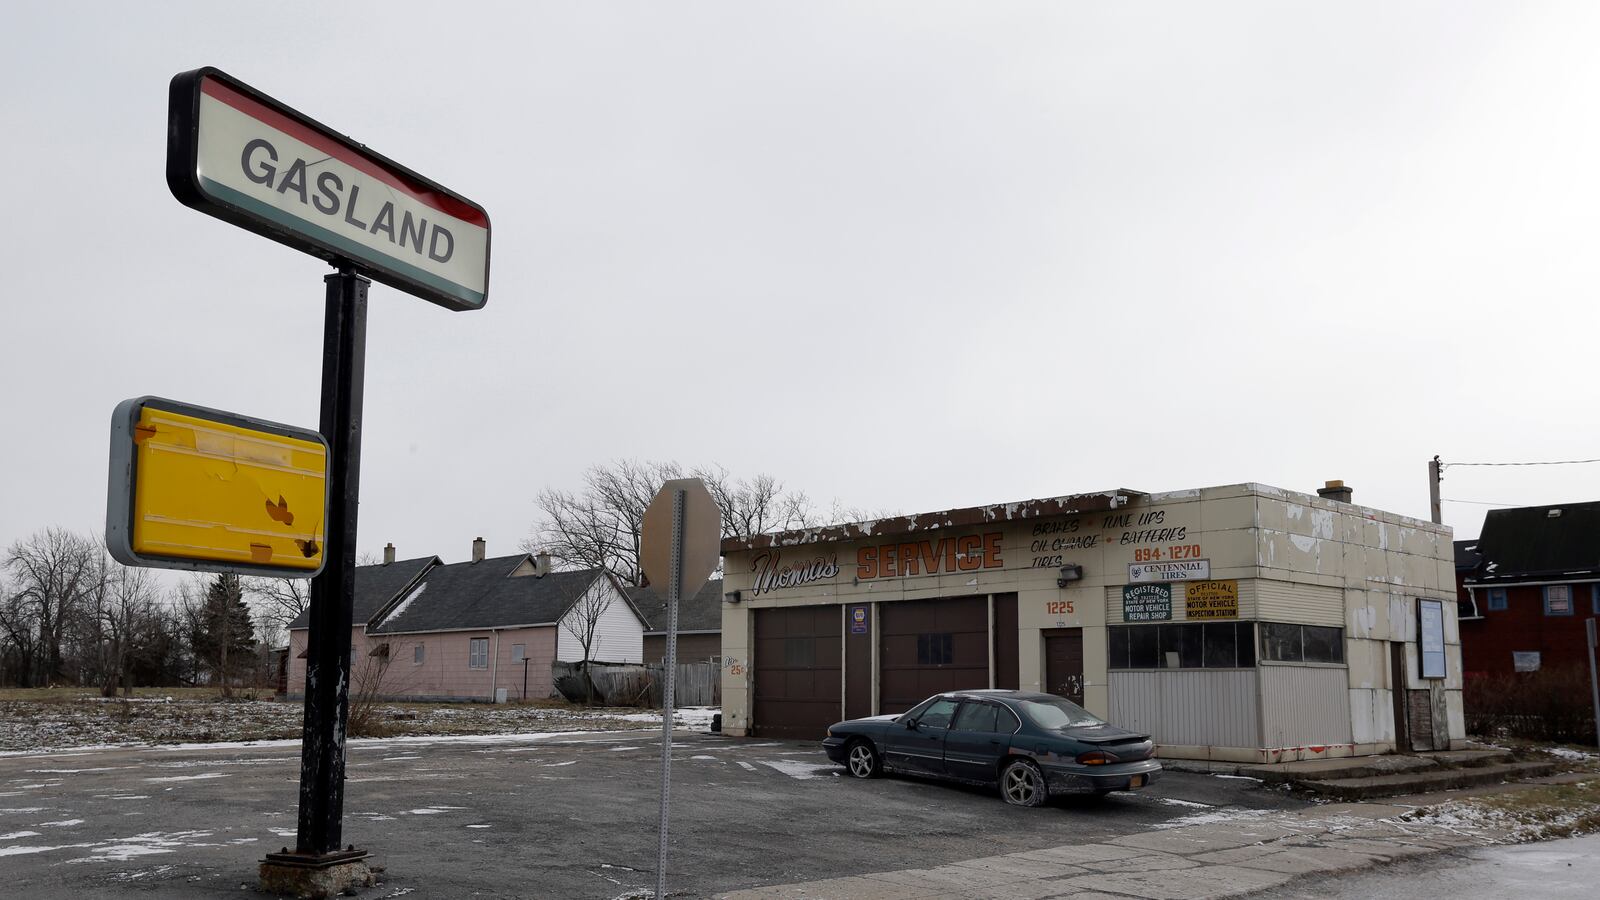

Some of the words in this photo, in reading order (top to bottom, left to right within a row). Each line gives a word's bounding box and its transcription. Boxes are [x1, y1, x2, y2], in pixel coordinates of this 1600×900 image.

[241, 138, 455, 264] GASLAND
[1032, 519, 1080, 536] BRAKES
[1103, 514, 1133, 529] TUNE
[1138, 510, 1165, 525] UPS
[1030, 540, 1048, 553] OIL
[1051, 535, 1099, 551] CHANGE
[1120, 526, 1186, 545] BATTERIES
[751, 549, 839, 597] Thomas
[857, 532, 1004, 580] SERVICE
[1032, 555, 1063, 568] TIRES
[1144, 562, 1203, 573] CENTENNIAL
[1160, 571, 1187, 580] TIRES
[1125, 585, 1169, 600] REGISTERED
[1189, 582, 1233, 595] OFFICIAL
[1046, 600, 1074, 614] 1225
[1125, 604, 1145, 612] MOTOR
[1145, 603, 1170, 611] VEHICLE
[1186, 600, 1208, 609] MOTOR
[1209, 599, 1236, 608] VEHICLE
[1129, 612, 1150, 620] REPAIR
[1151, 611, 1167, 619] SHOP
[1186, 610, 1215, 618] INSPECTION
[1215, 608, 1237, 617] STATION
